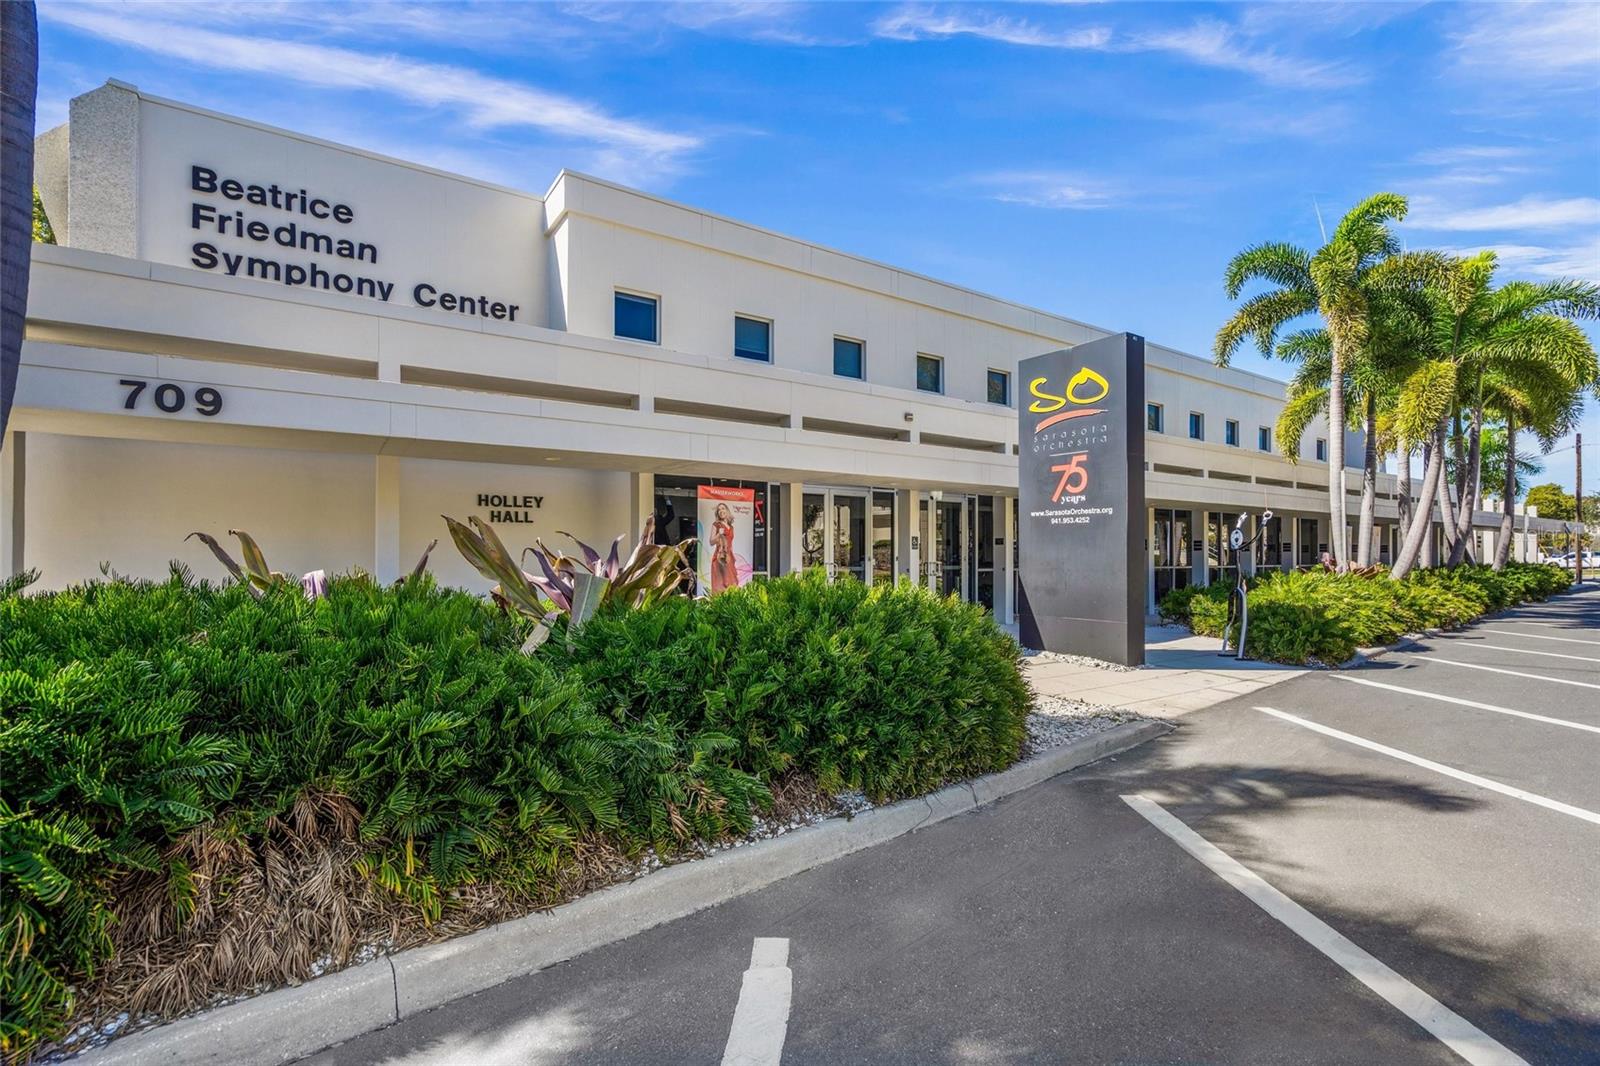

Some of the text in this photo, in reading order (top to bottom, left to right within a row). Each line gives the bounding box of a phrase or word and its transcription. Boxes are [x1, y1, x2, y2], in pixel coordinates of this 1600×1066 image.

[192, 165, 354, 224] Beatrice
[191, 203, 378, 264] Friedman
[191, 242, 520, 322] Symphony Center
[119, 379, 223, 416] 709
[1033, 435, 1108, 453] orchestra
[1051, 454, 1088, 503] 75
[477, 494, 544, 508] HOLLEY
[1060, 495, 1087, 504] years
[490, 510, 534, 523] HALL
[1030, 507, 1113, 517] www.SarasotaOrchestra.org
[1050, 516, 1090, 525] 941.953.4252
